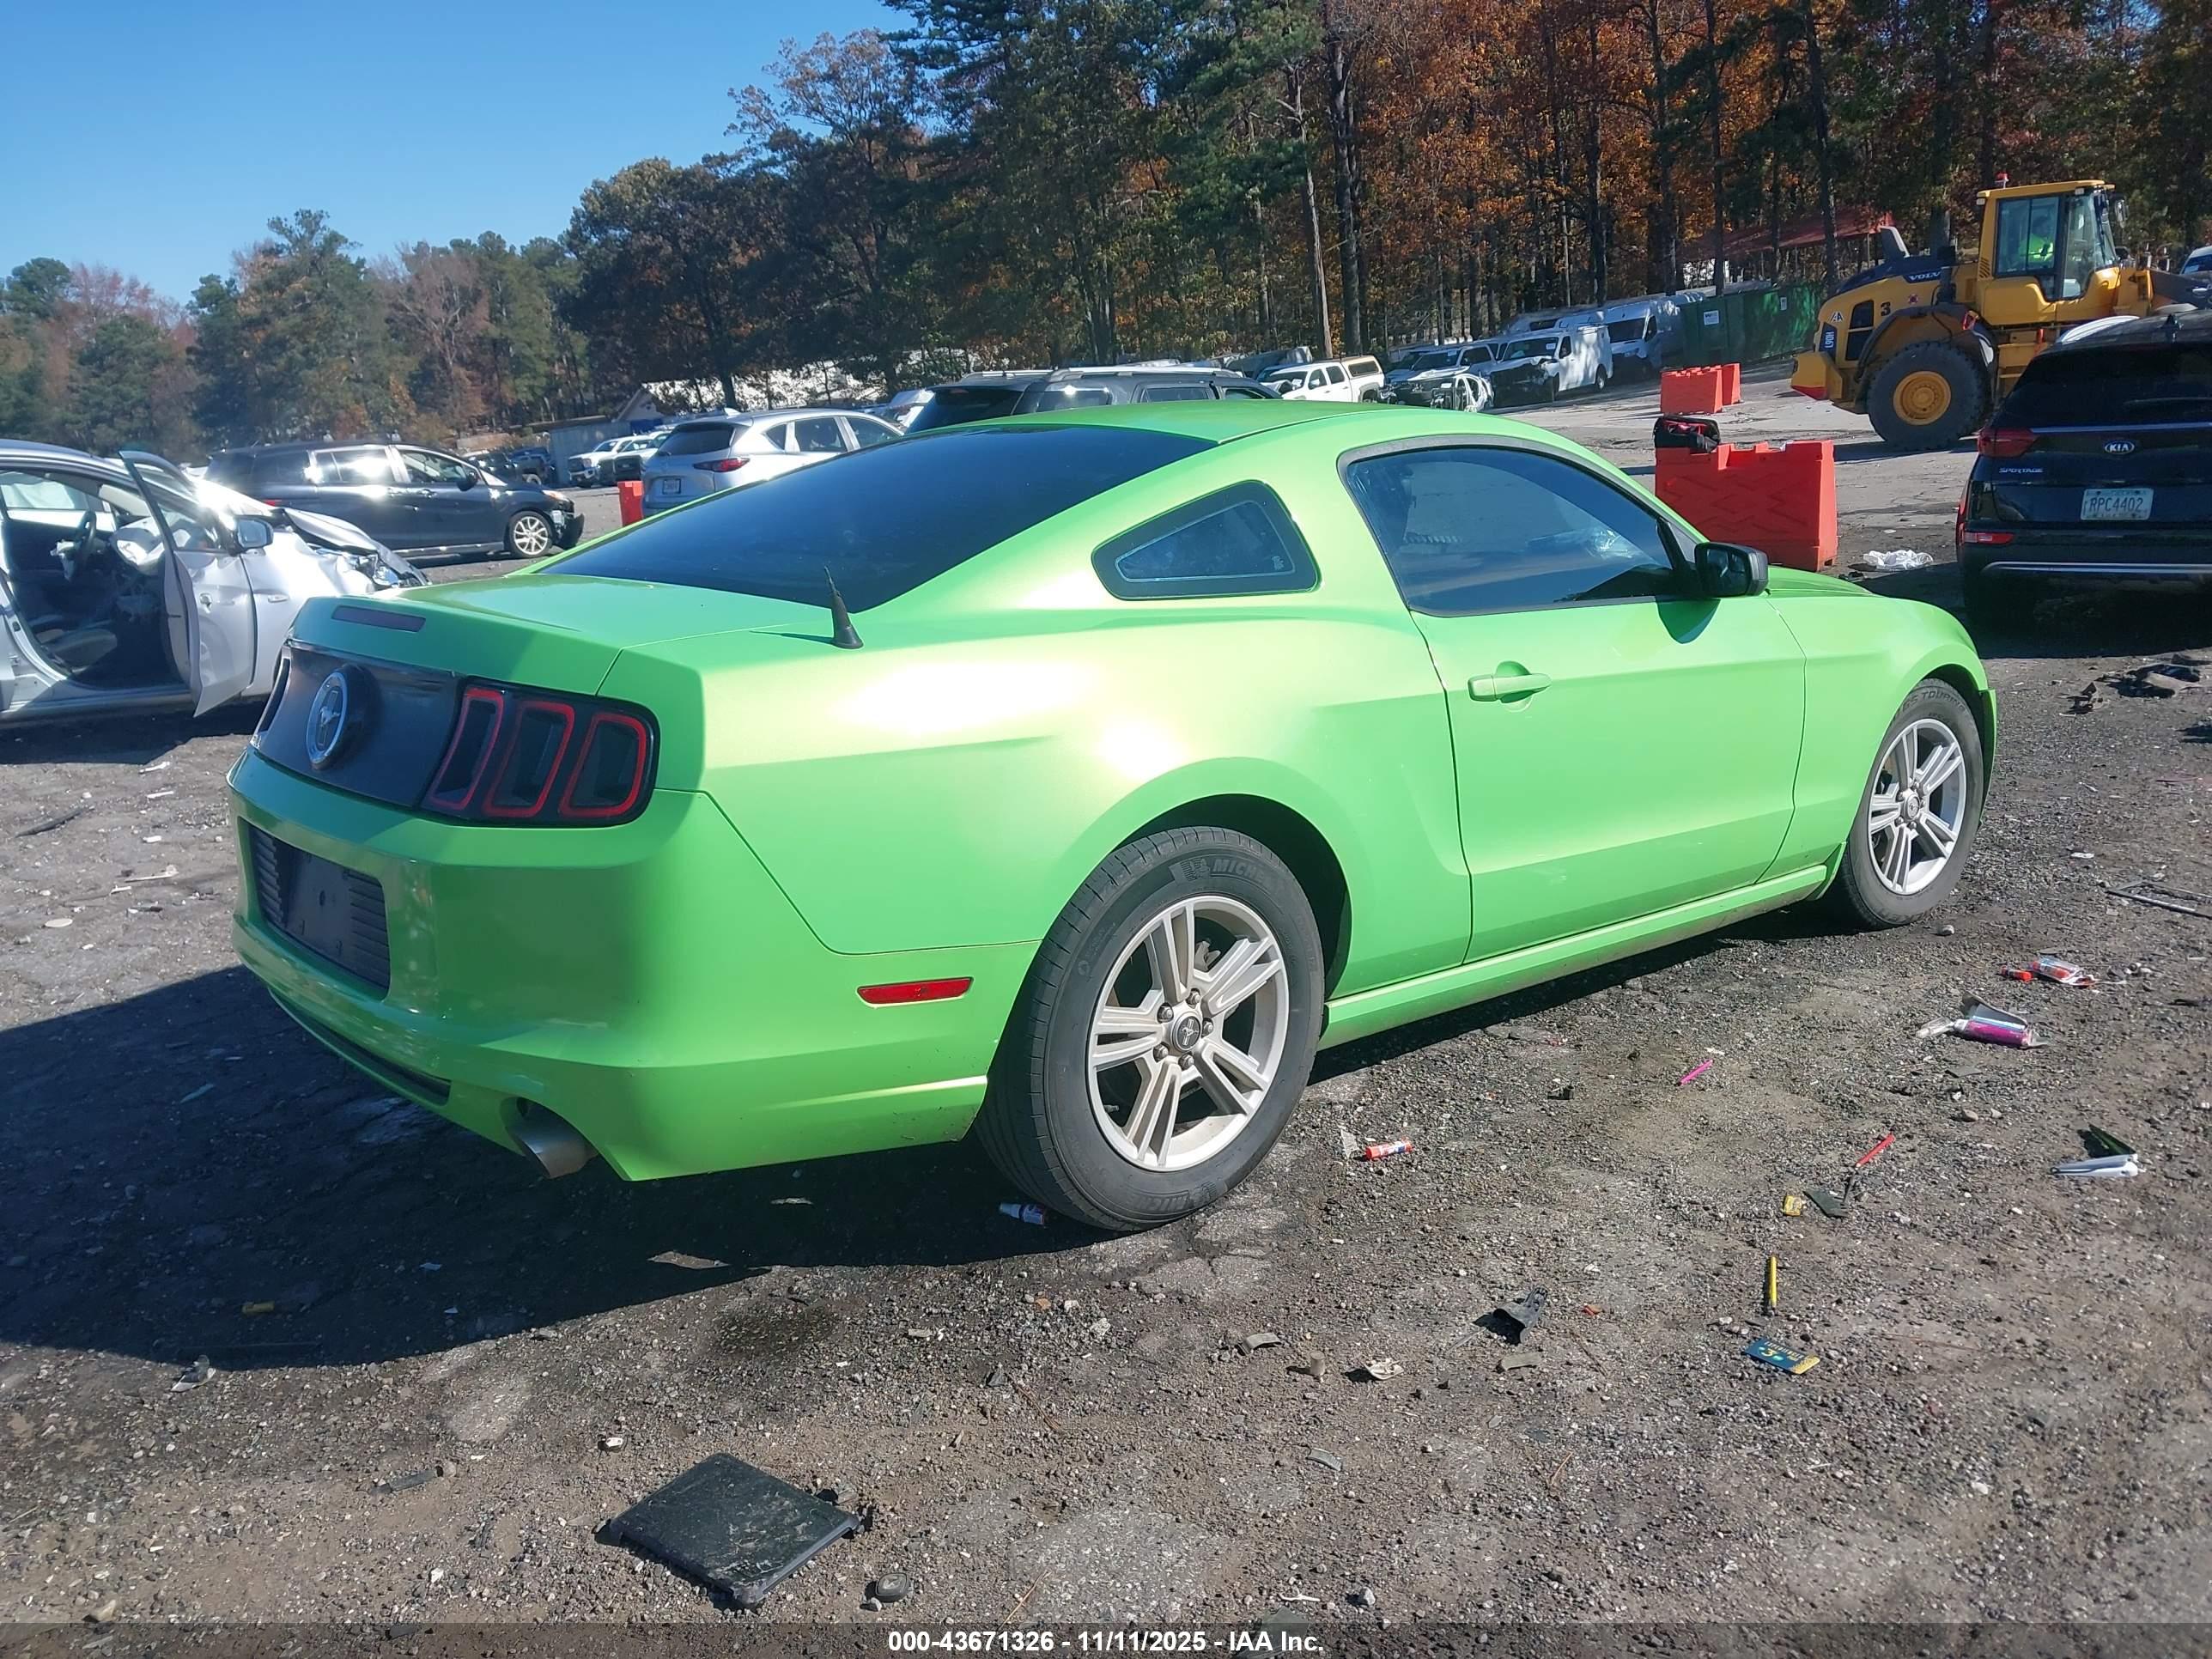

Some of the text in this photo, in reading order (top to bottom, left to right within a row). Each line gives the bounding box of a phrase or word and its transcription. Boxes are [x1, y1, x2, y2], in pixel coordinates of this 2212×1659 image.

[1908, 271, 1941, 281] VOLV
[1881, 301, 1891, 317] 3
[1824, 331, 1835, 349] L90H
[2109, 443, 2130, 453] KIA
[2089, 497, 2143, 511] RPC4402
